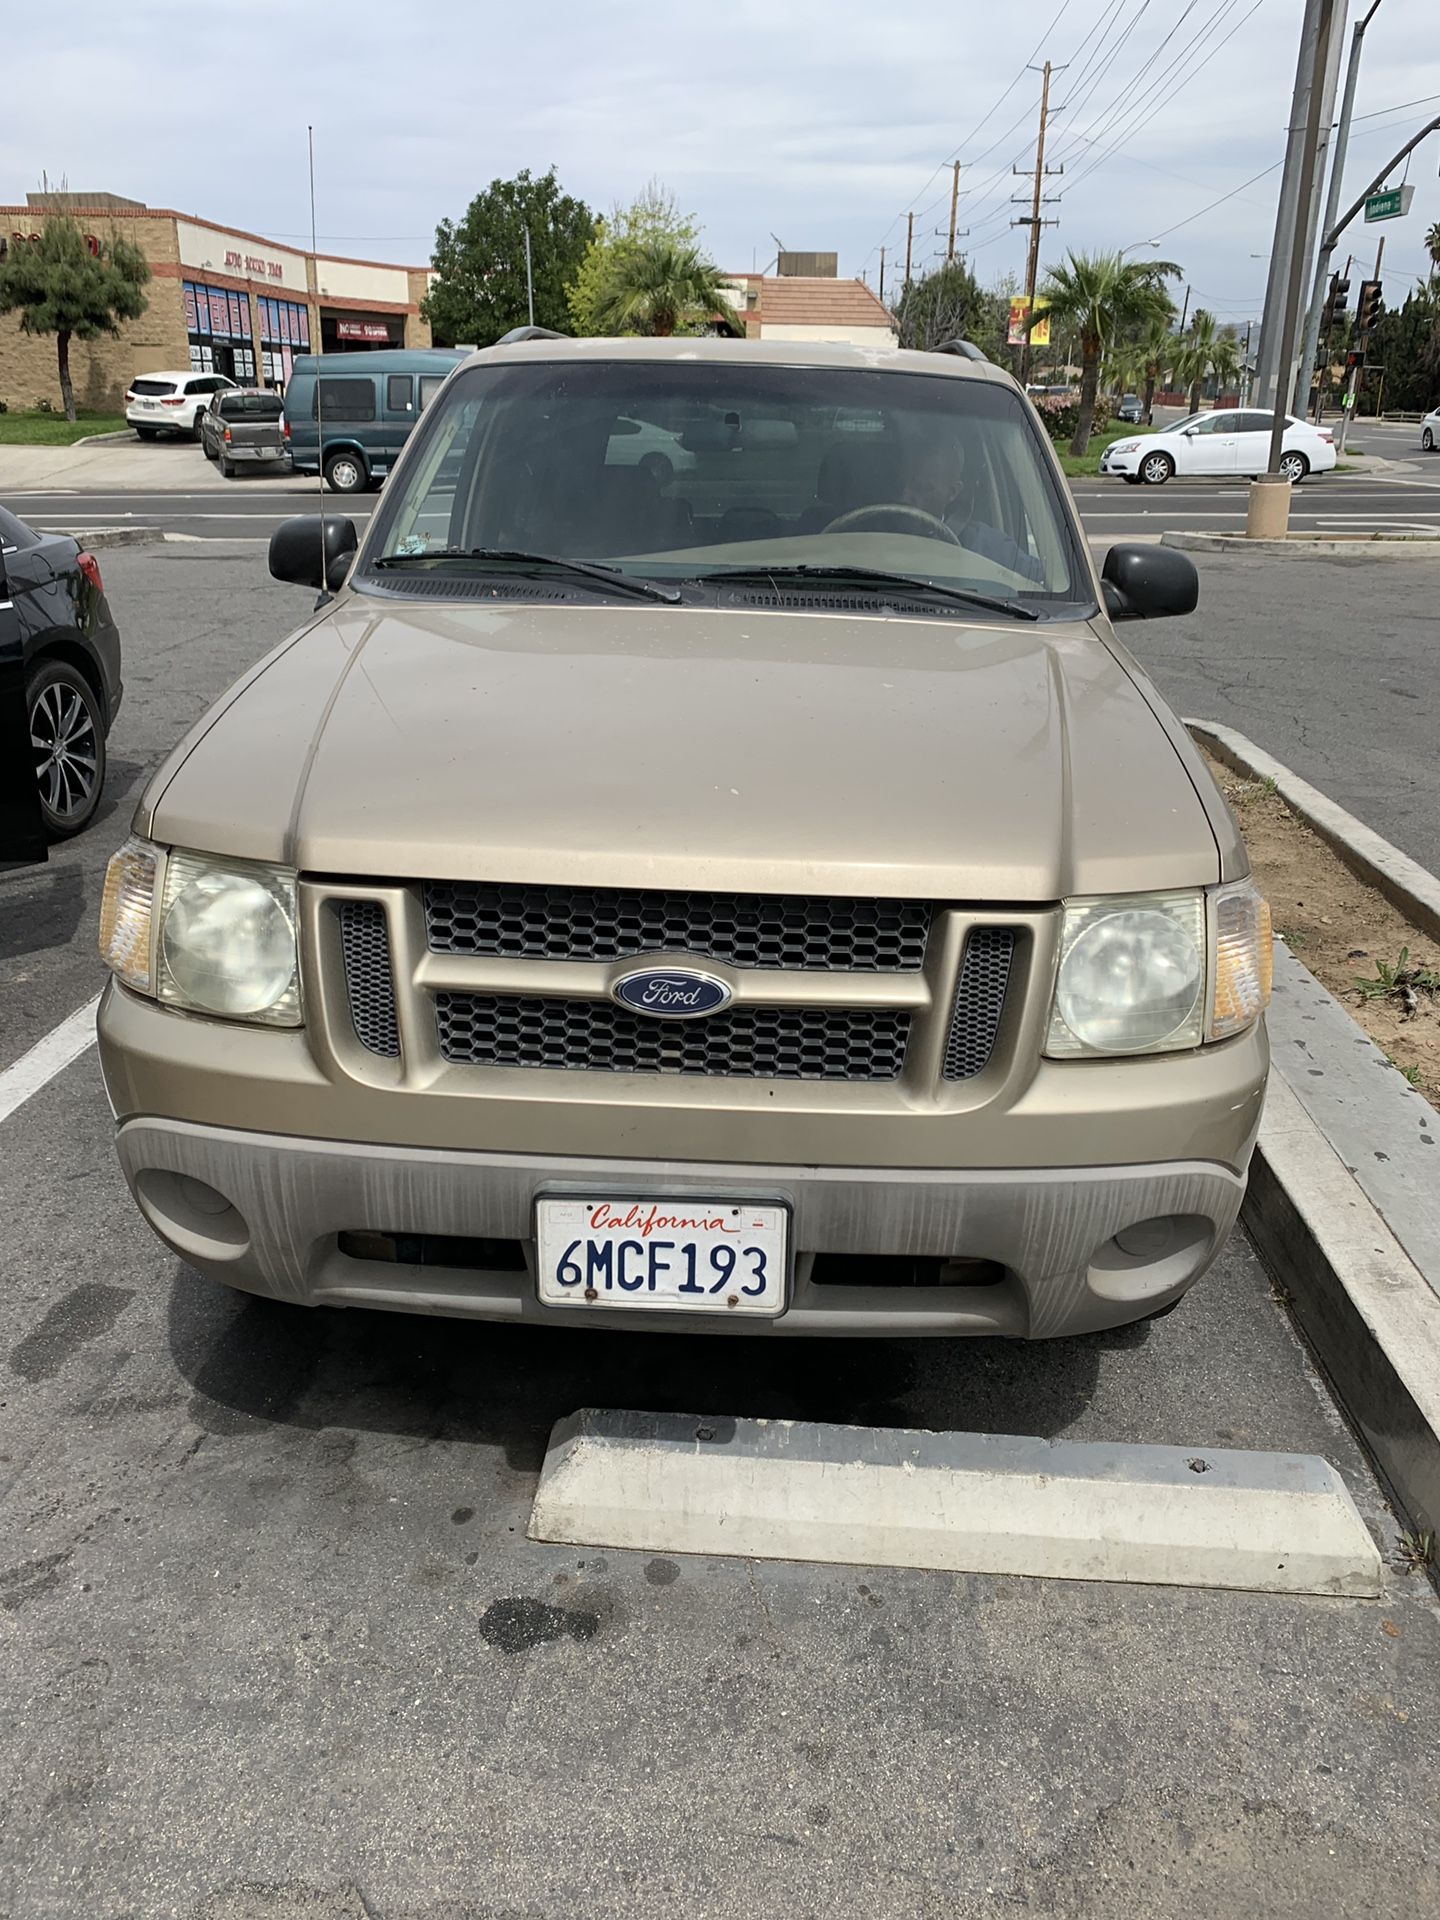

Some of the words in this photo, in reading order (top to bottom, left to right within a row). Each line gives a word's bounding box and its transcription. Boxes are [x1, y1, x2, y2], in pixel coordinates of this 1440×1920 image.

[184, 290, 250, 335] STEREO
[258, 303, 309, 341] ALARM
[642, 979, 702, 1005] Ford
[590, 1203, 741, 1237] California
[556, 1239, 768, 1296] 6MCF193
